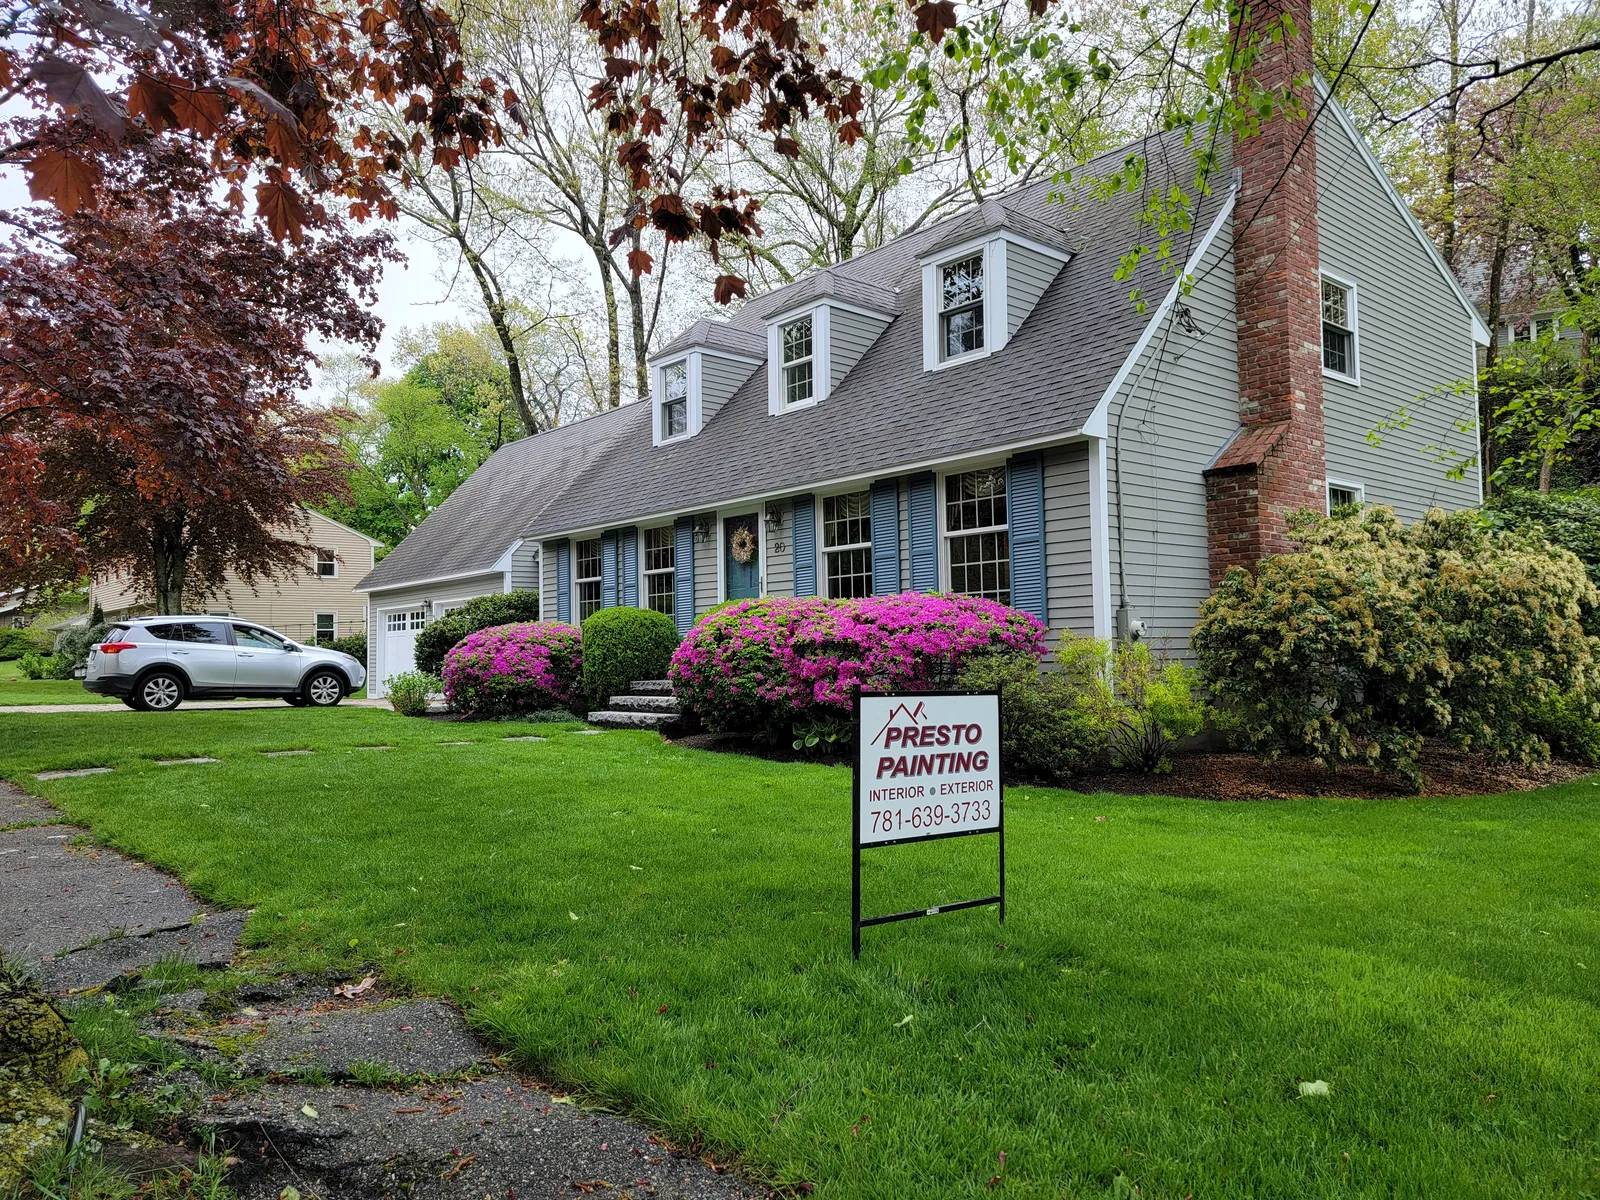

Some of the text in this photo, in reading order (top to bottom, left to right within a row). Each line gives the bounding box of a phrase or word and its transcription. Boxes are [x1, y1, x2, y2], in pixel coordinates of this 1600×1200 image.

[774, 542, 785, 553] 20
[884, 723, 982, 749] PRESTO
[876, 750, 989, 779] PAINTING
[869, 780, 994, 802] INTERIOR EXTERIOR
[871, 799, 991, 833] 781-639-3733
